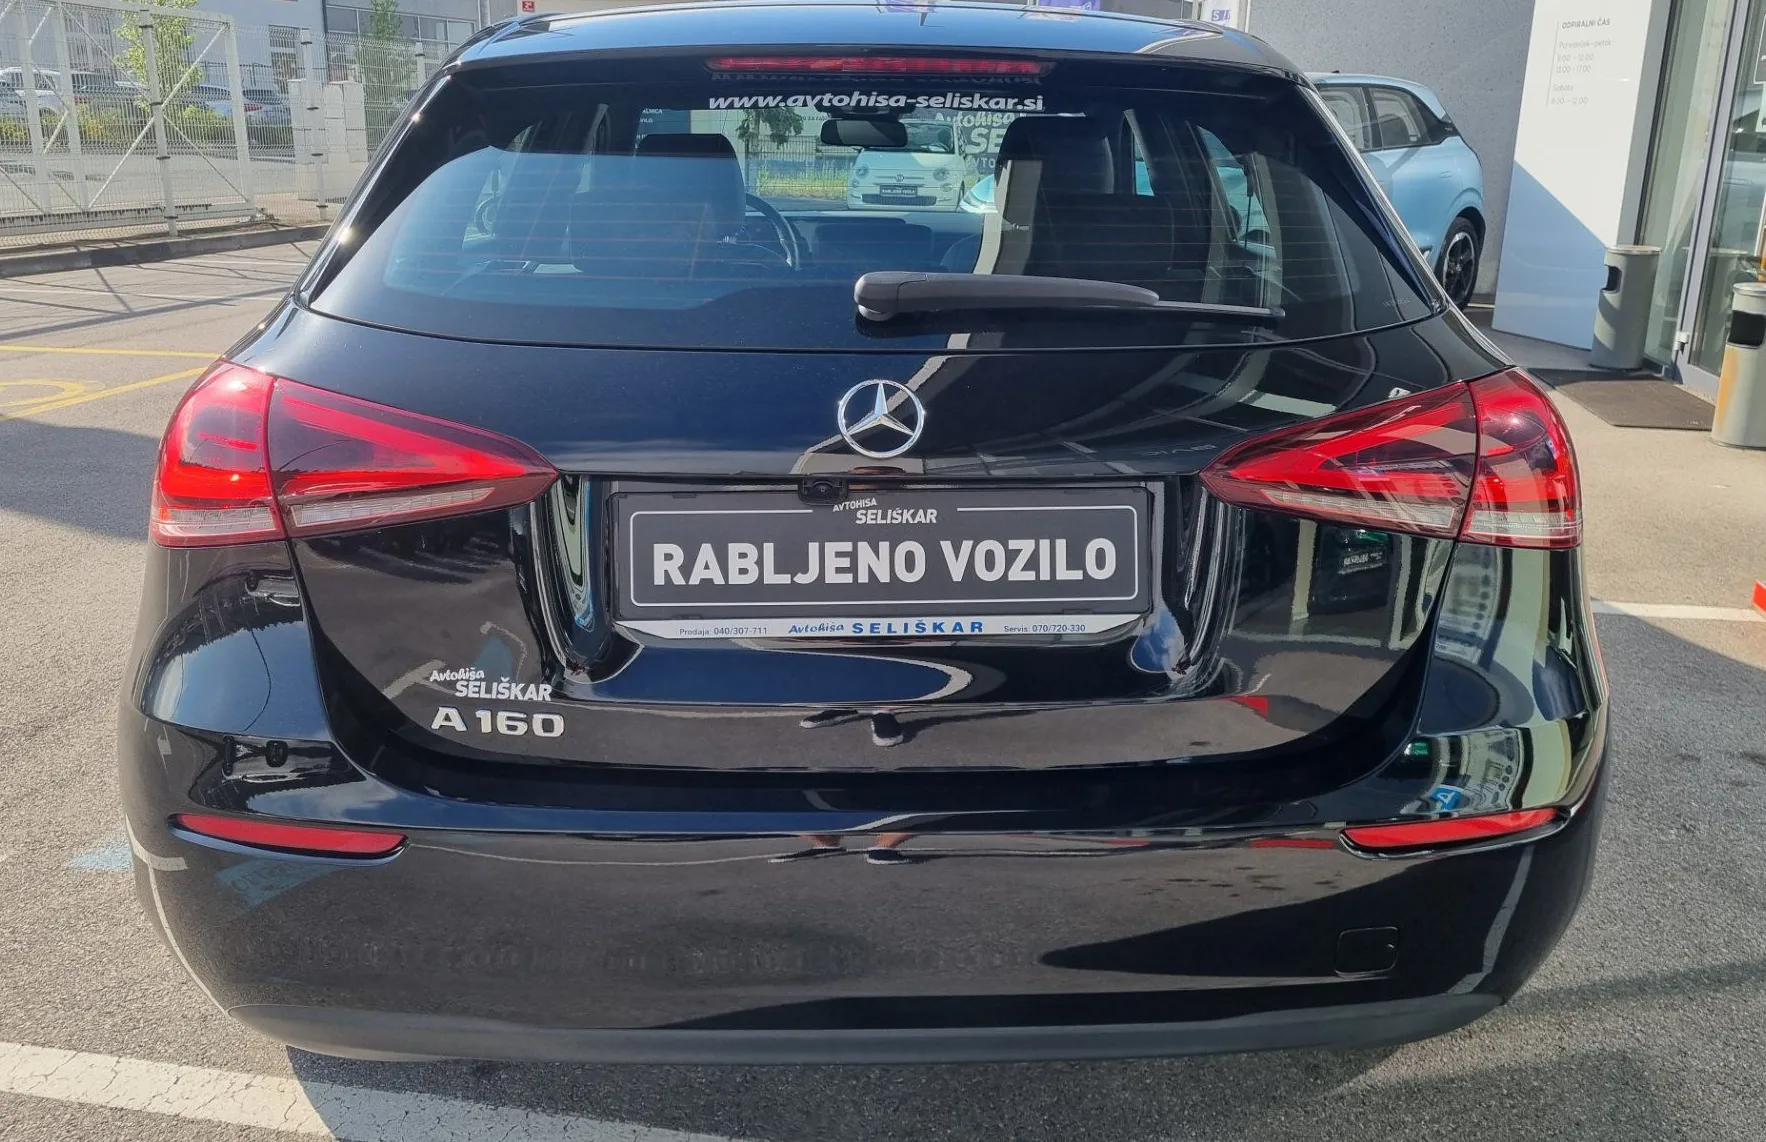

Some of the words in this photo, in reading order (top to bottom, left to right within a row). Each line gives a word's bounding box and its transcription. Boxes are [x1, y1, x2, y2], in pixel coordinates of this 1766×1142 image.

[709, 91, 1044, 111] www.avtohisa-seliskar.si
[855, 507, 938, 524] SELIŠKAR
[653, 540, 926, 586] RABLJENO
[940, 538, 1117, 582] VOZILO
[713, 627, 768, 635] 040/307-711
[852, 619, 983, 634] SELIŠKAR
[1032, 624, 1086, 633] 070/720-330
[455, 676, 553, 701] SELIŠKAR
[431, 706, 468, 732] A
[475, 709, 565, 738] 160
